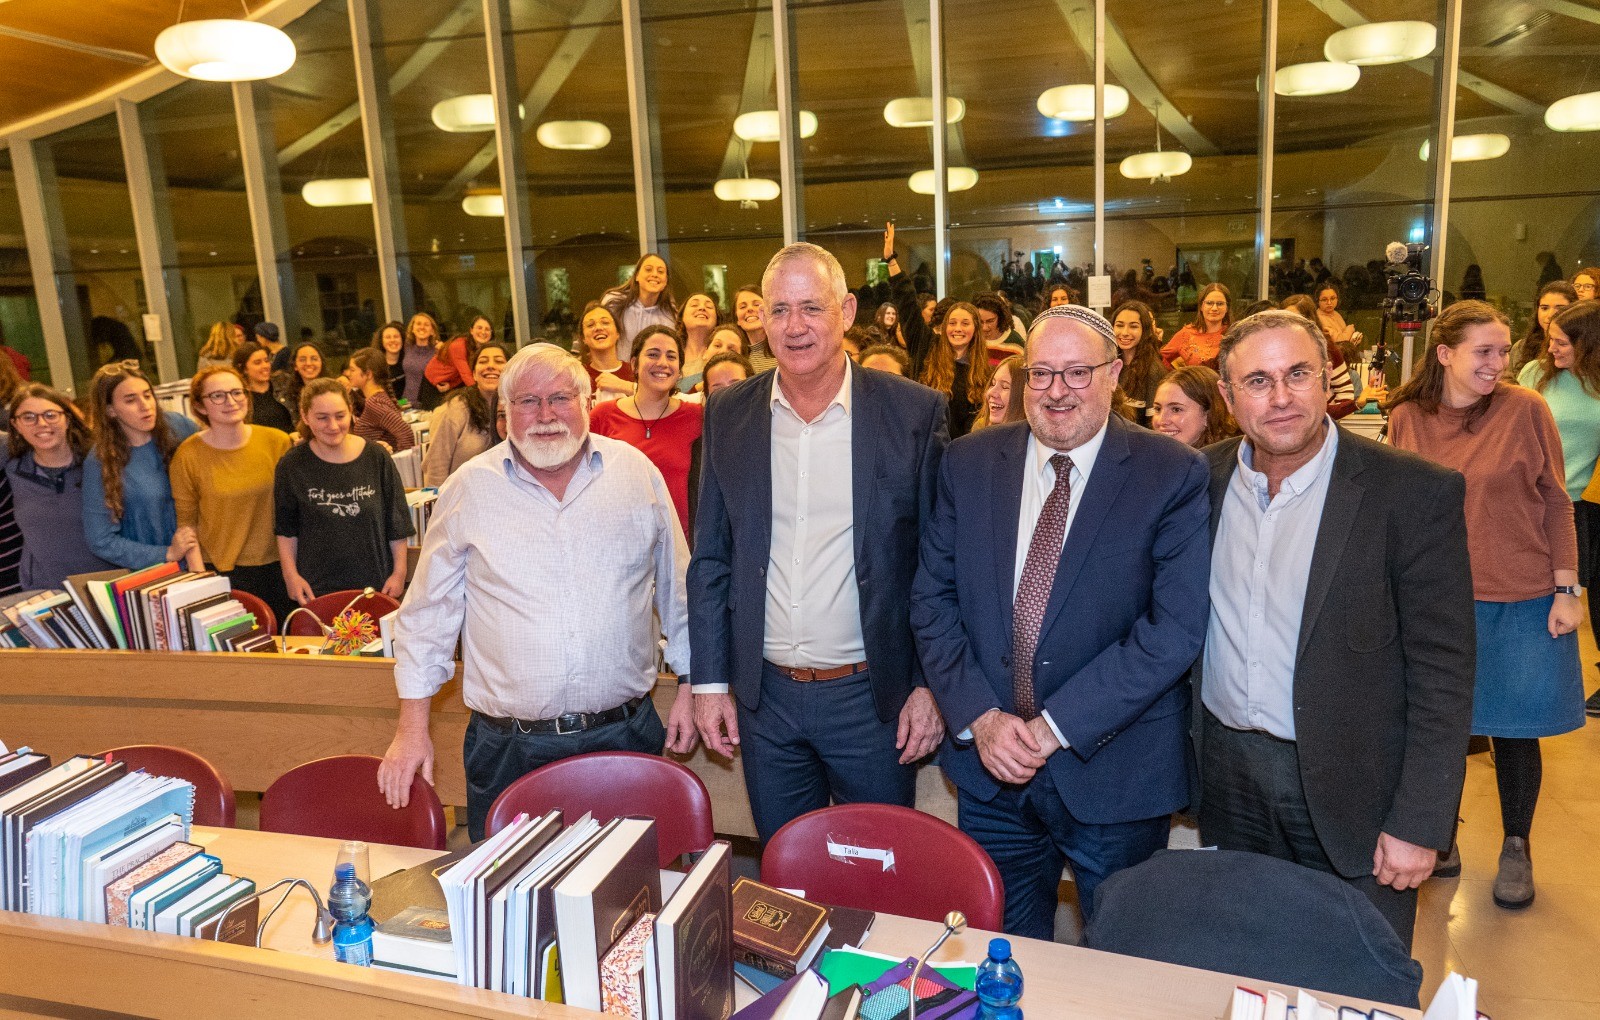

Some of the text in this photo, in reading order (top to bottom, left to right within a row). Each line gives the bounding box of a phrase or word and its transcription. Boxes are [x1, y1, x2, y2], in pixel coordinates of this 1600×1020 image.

[308, 488, 325, 501] First
[327, 492, 345, 505] goes
[844, 847, 859, 856] Talia
[112, 865, 125, 877] THE
